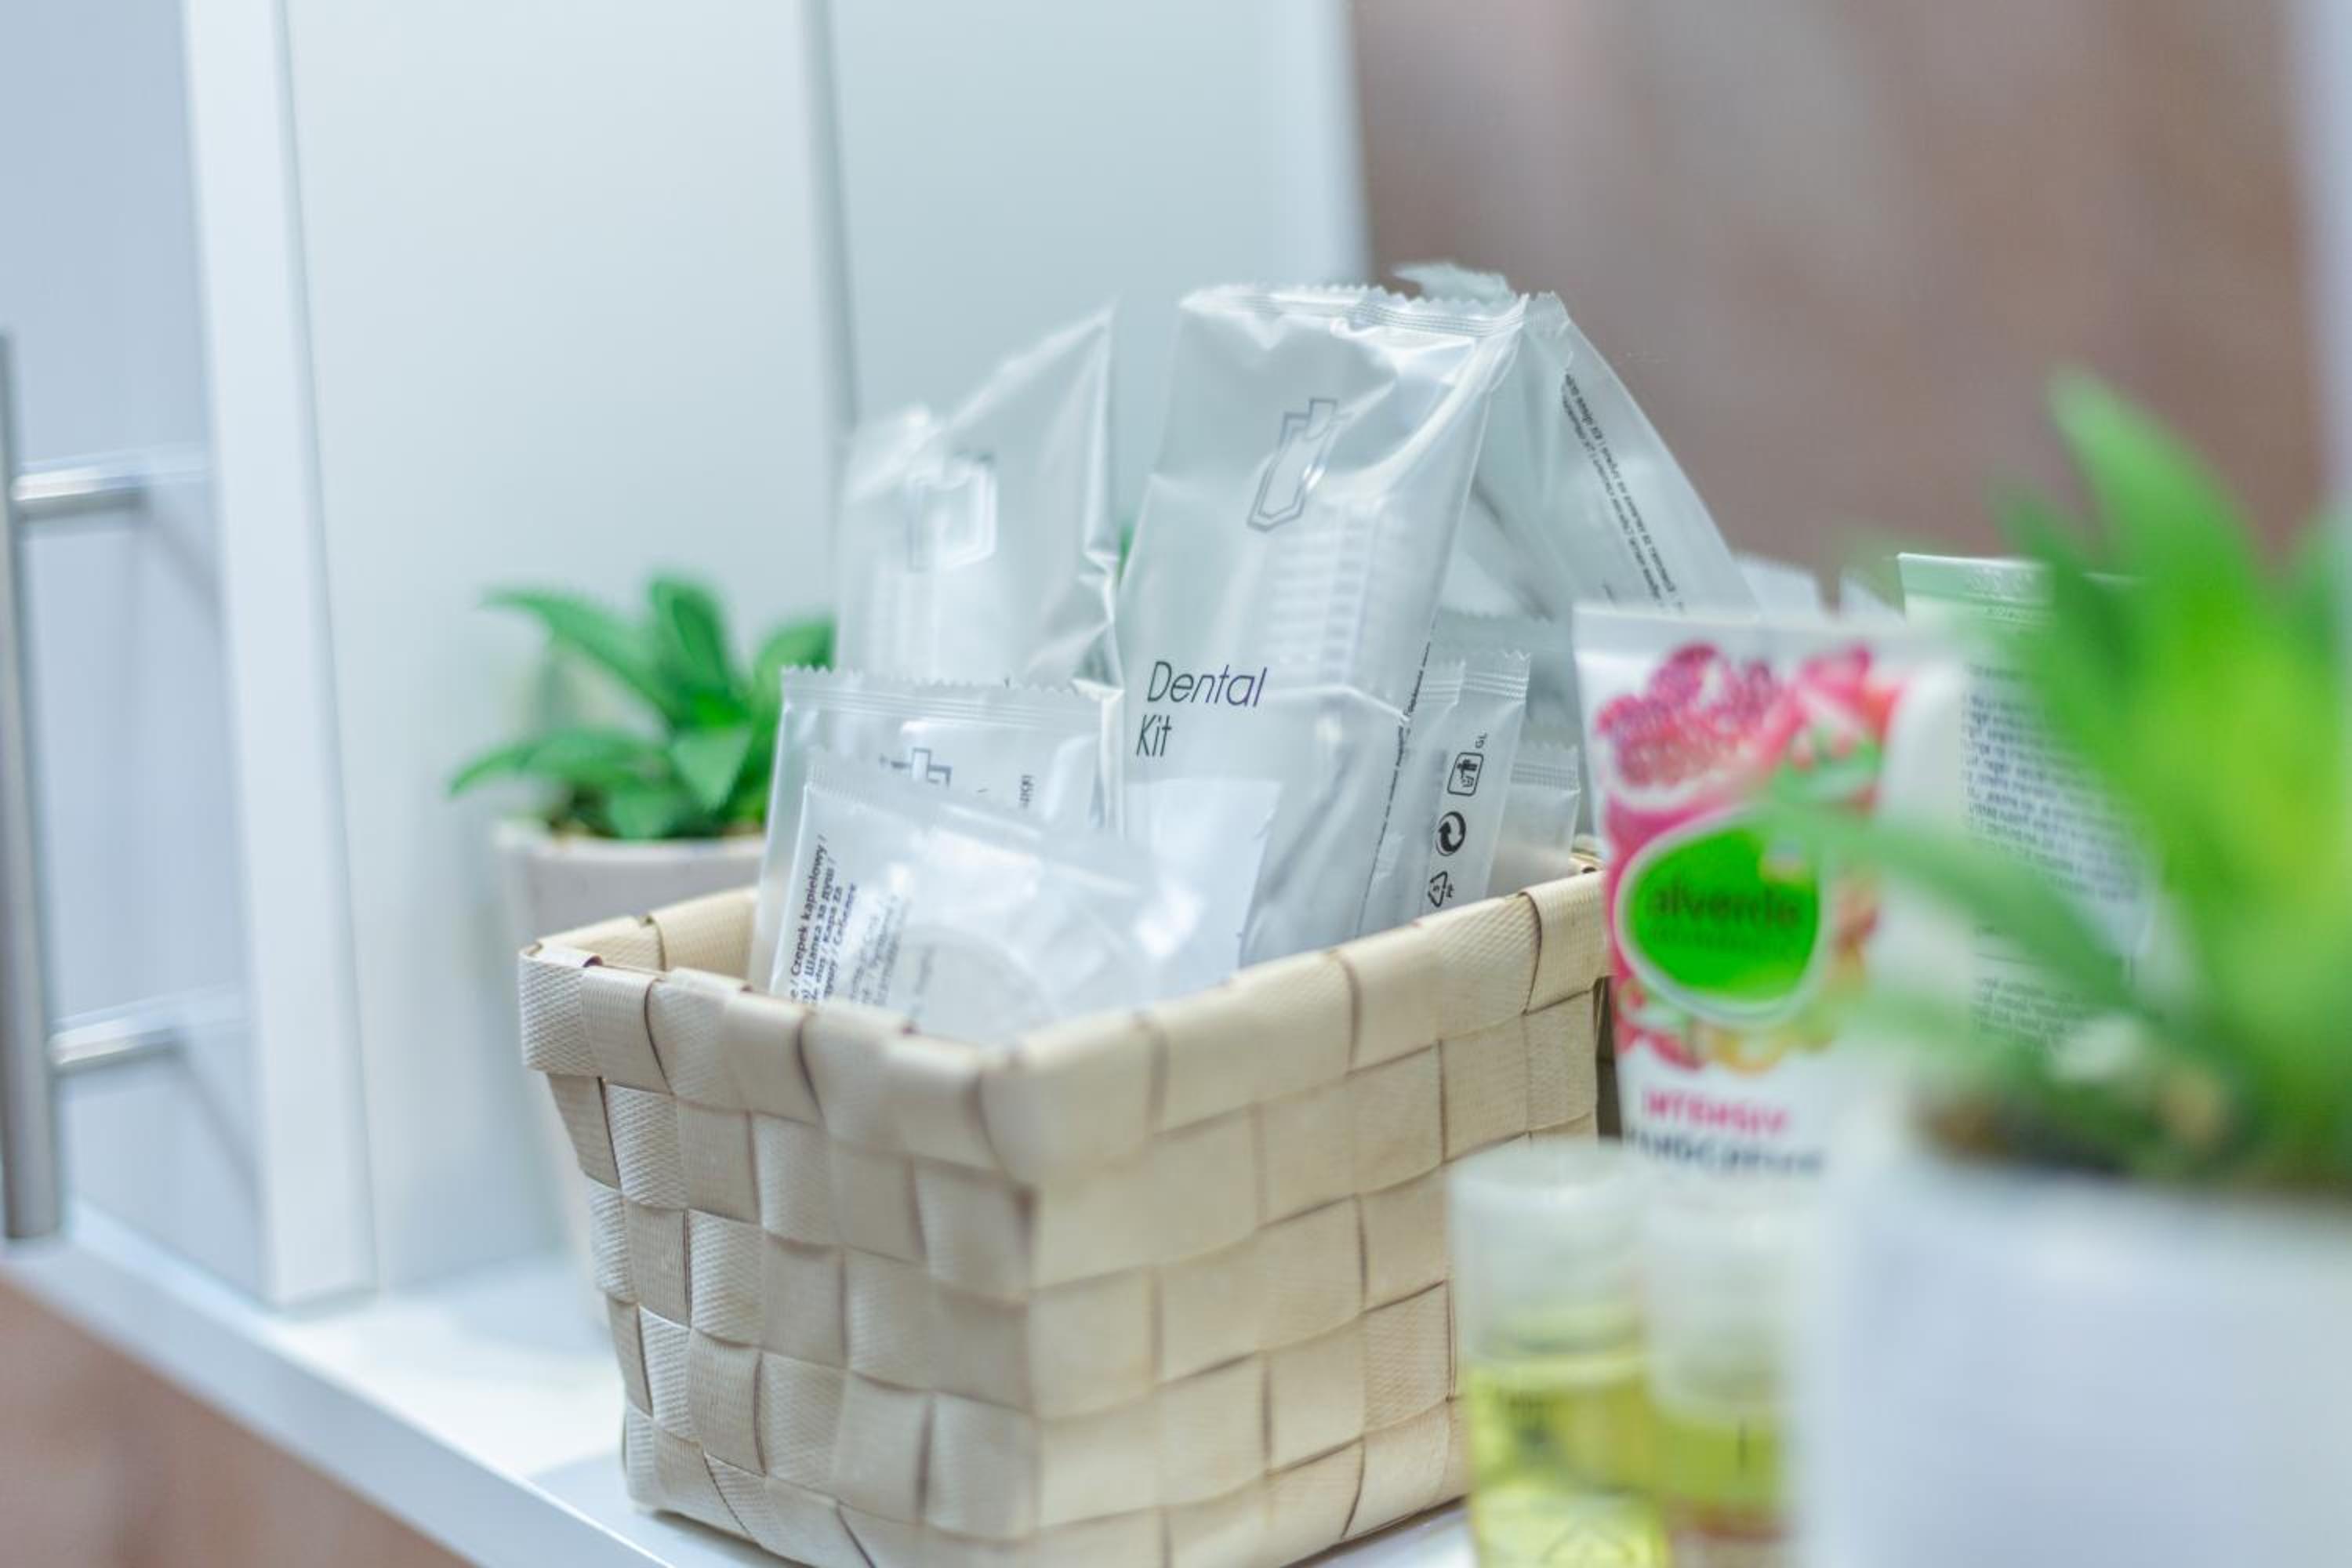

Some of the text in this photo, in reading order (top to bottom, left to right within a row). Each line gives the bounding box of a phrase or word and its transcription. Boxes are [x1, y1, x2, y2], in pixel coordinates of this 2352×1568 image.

[1147, 660, 1267, 707] Dental
[1136, 714, 1172, 757] Kit
[1650, 874, 1802, 928] alverde
[790, 925, 809, 976] Czepek
